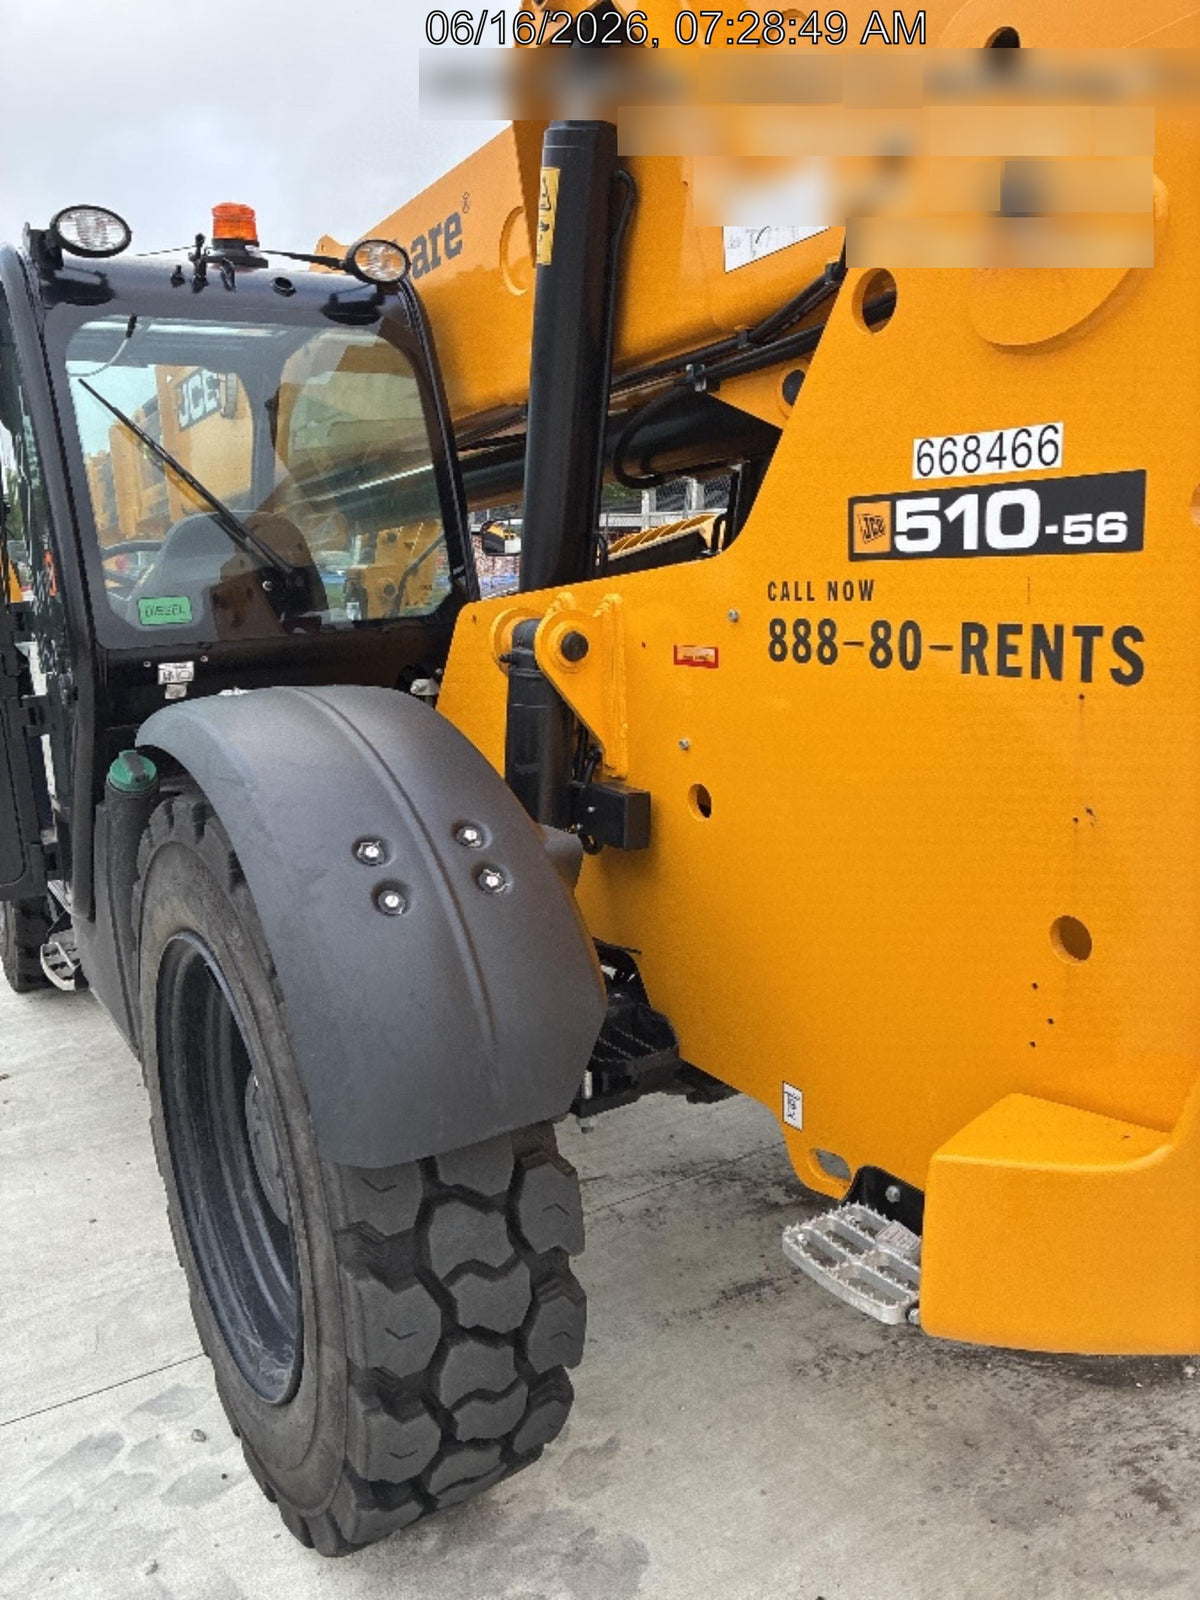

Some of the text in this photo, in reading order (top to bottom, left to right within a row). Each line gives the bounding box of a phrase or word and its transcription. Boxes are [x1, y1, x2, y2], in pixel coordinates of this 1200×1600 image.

[916, 424, 1060, 477] 668466
[894, 488, 1128, 553] 510-56
[145, 603, 186, 618] DIESEL
[767, 579, 875, 601] CALL NOW
[767, 617, 1146, 687] 888-80-RENTS
